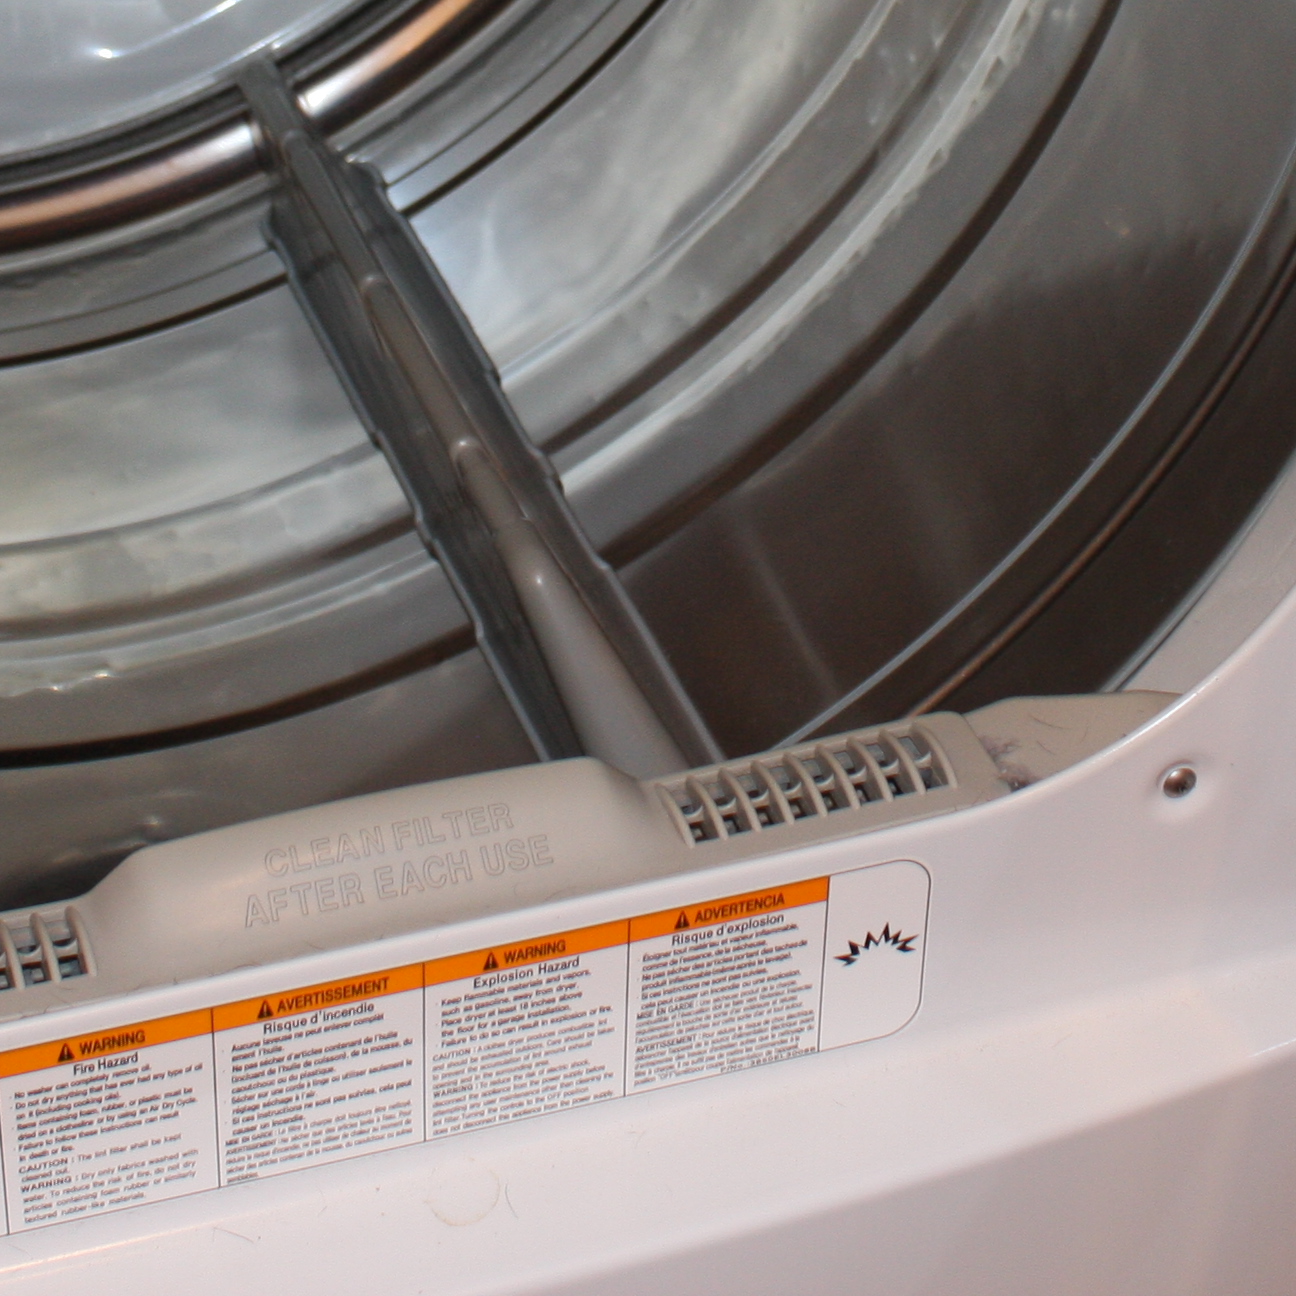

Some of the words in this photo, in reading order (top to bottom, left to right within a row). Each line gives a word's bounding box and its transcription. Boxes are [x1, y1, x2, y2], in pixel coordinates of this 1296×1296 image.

[264, 826, 385, 878] CLEAN
[392, 803, 515, 851] FILTER
[245, 872, 365, 929] AFTER
[374, 850, 472, 900] EACH
[480, 834, 554, 876] USE
[695, 892, 784, 922] ADVERTENCIA
[671, 927, 712, 947] Risque
[716, 914, 784, 936] d'explosion
[504, 939, 565, 963] WARNING
[473, 966, 533, 988] Explosion
[538, 956, 579, 974] Hazard
[277, 977, 388, 1012] AVERTISSEMENT
[263, 1015, 306, 1036] Risque
[310, 1002, 373, 1024] d'incendie
[79, 1029, 145, 1055] WARNING
[432, 1048, 470, 1061] CAUTION
[73, 1061, 94, 1075] Fire
[97, 1052, 138, 1070] Hazard
[14, 1091, 24, 1099] No
[27, 1086, 52, 1096] washer
[70, 1073, 109, 1087] completely
[112, 1068, 138, 1077] remove
[15, 1101, 25, 1109] Do
[41, 1096, 53, 1105] dry
[55, 1089, 87, 1102] anything
[89, 1085, 102, 1093] that
[104, 1082, 117, 1090] has
[137, 1075, 150, 1083] had
[152, 1073, 165, 1081] any
[167, 1068, 182, 1077] type
[433, 1083, 473, 1098] WARNING
[39, 1113, 77, 1126] containing
[138, 1094, 160, 1104] plastic
[164, 1090, 181, 1098] must
[73, 1096, 102, 1108] cooking
[17, 1132, 36, 1141] dried
[106, 1114, 115, 1122] by
[117, 1110, 136, 1120] using
[162, 1101, 174, 1110] Dry
[176, 1096, 198, 1106] Cycle.
[18, 1140, 43, 1151] Failure
[54, 1133, 76, 1143] follow
[78, 1129, 97, 1138] these
[159, 1111, 179, 1120] result
[18, 1157, 68, 1174] CAUTION
[29, 1150, 49, 1159] death
[60, 1144, 74, 1152] fire.
[20, 1176, 71, 1193] WARNING
